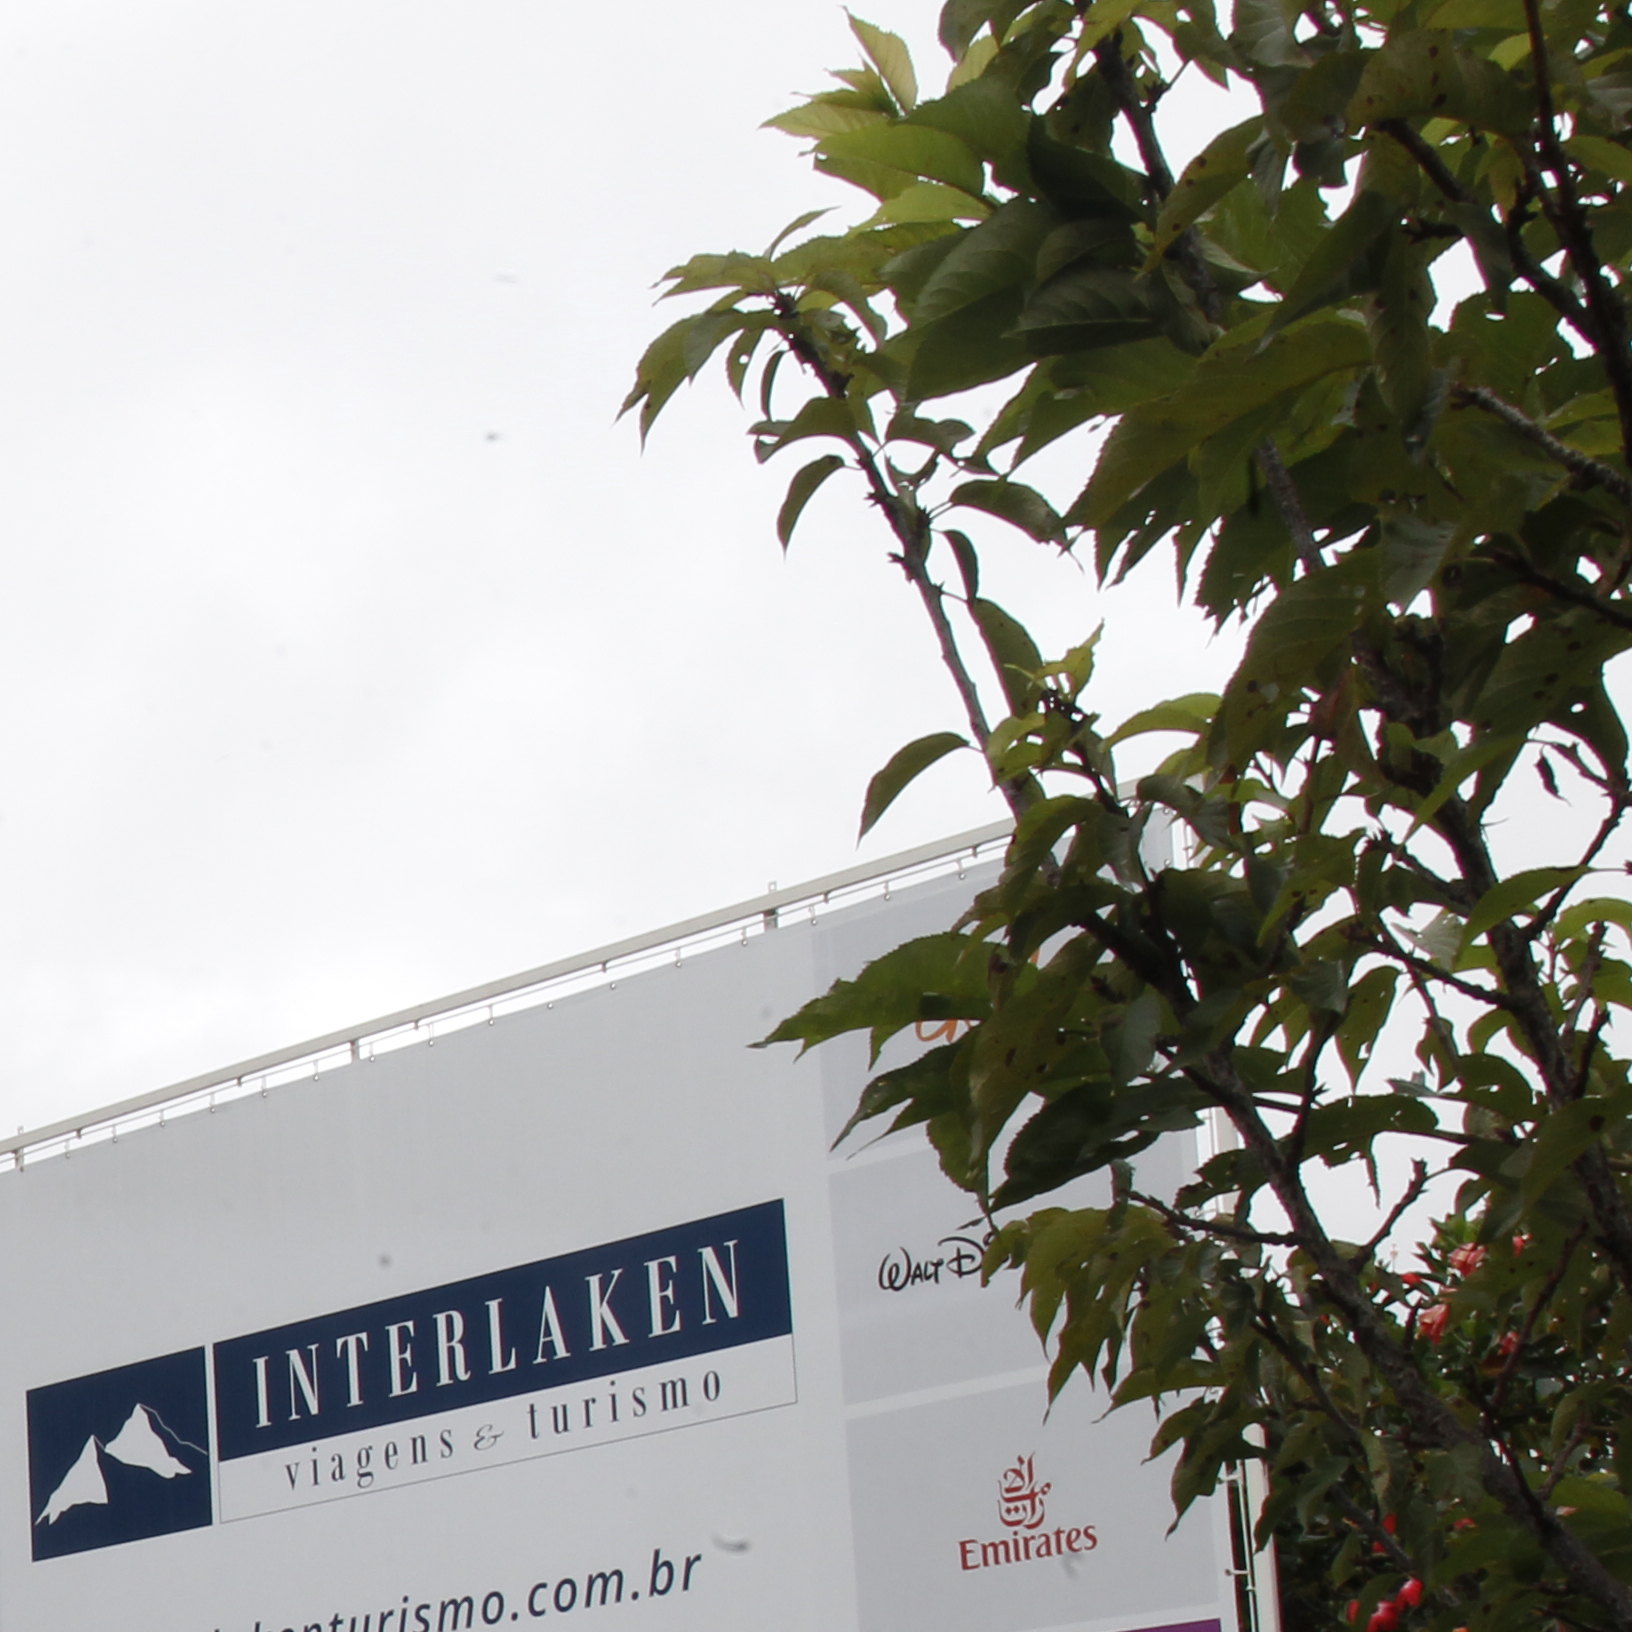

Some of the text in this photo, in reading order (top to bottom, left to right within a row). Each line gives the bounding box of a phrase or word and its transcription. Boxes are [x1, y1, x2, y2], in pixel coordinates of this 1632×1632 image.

[252, 1240, 739, 1429] INTERLAKEN
[284, 1369, 721, 1489] viagens & turismo
[958, 1525, 1098, 1571] Emirates
